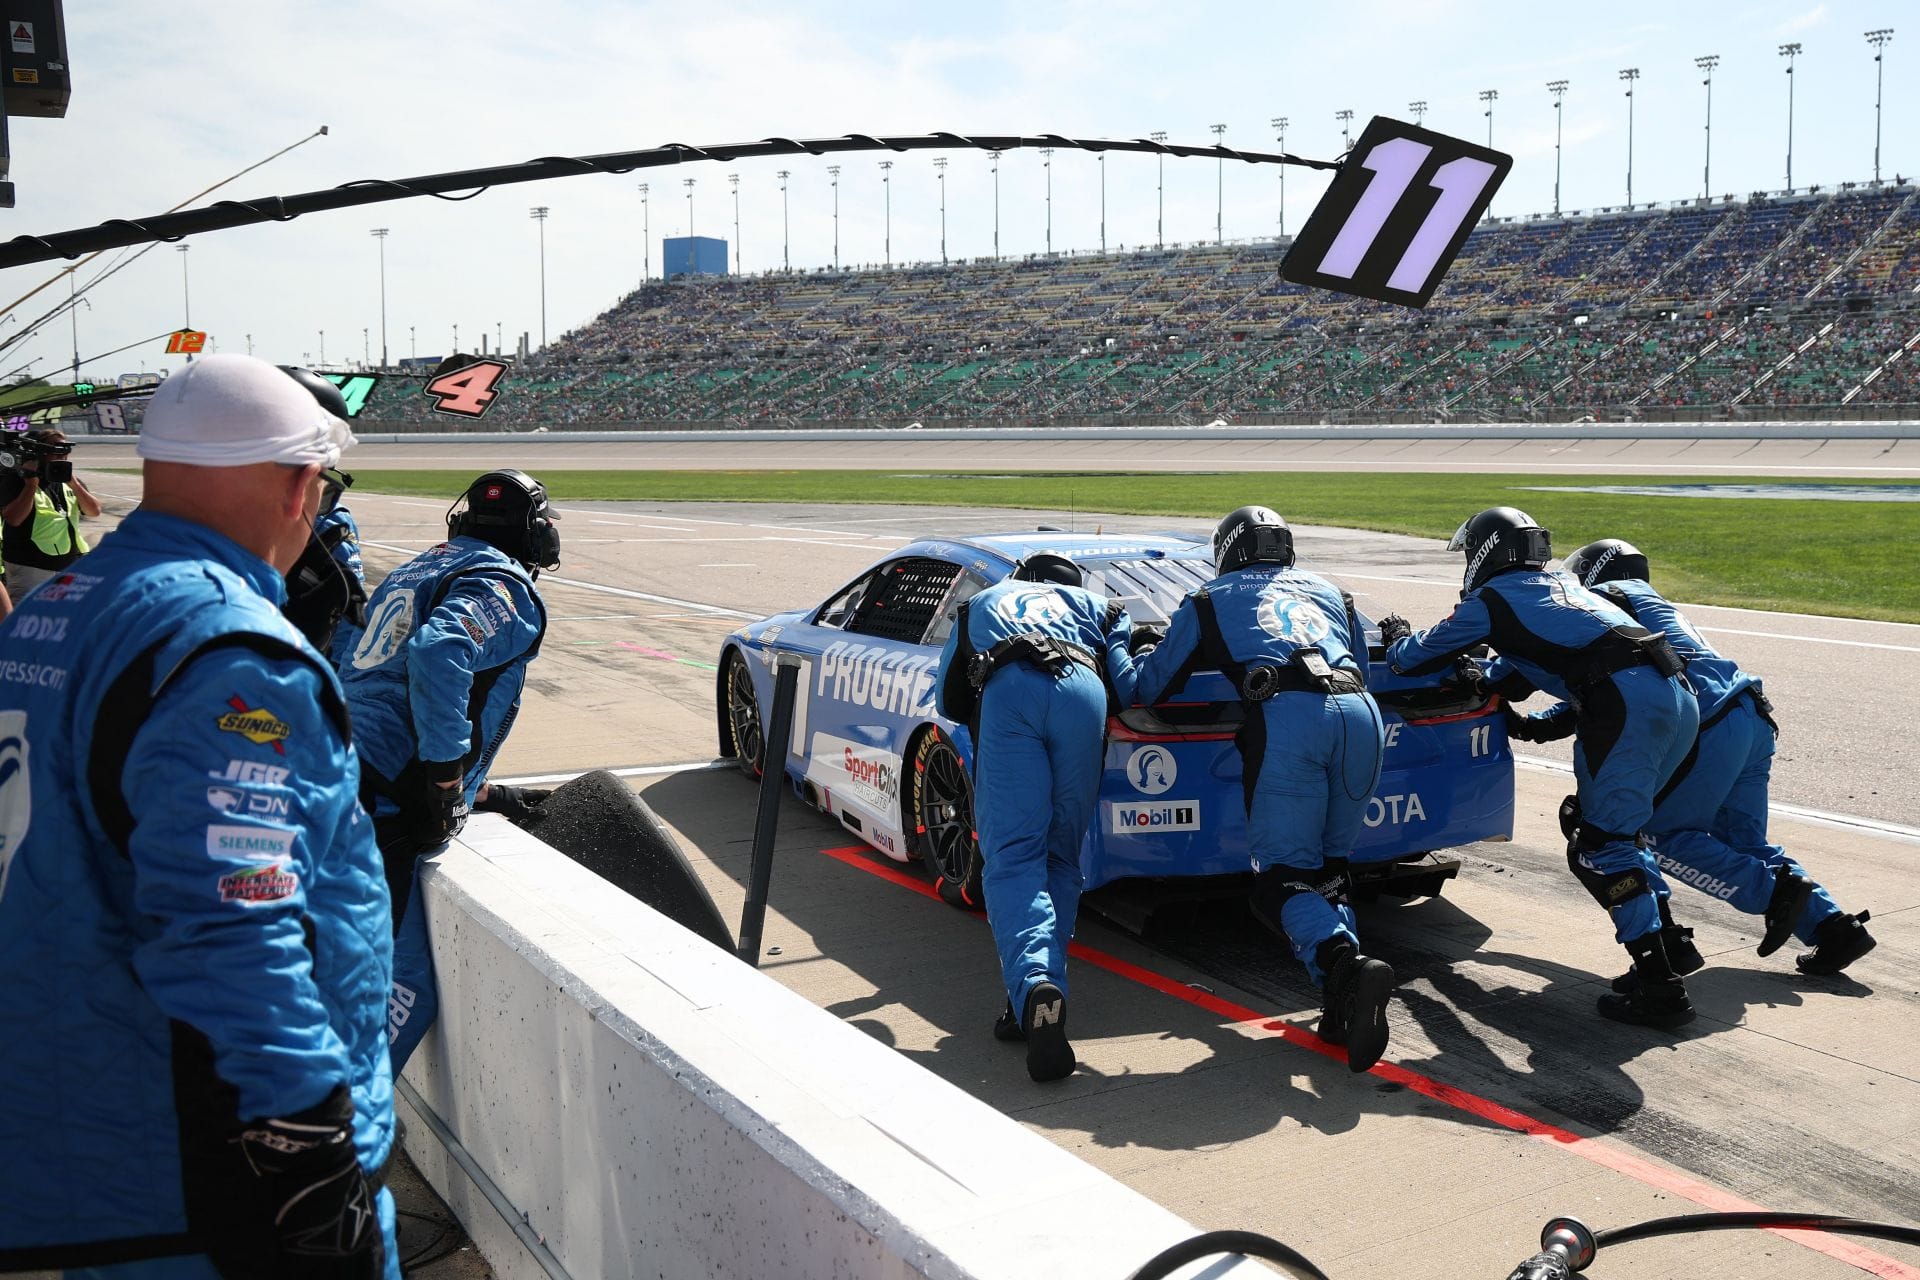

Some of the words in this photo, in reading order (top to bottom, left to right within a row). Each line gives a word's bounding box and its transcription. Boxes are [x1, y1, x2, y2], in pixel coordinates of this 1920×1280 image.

[1316, 137, 1498, 294] 11
[165, 332, 206, 353] 12
[428, 360, 506, 417] 4
[97, 403, 127, 430] 8
[818, 640, 939, 719] PROGRE
[224, 715, 290, 738] SUNOCO
[1470, 725, 1490, 758] 11
[208, 760, 290, 786] JGR
[1119, 809, 1172, 826] Mobil
[219, 836, 285, 850] SIEMENS
[873, 827, 888, 849] Mobil
